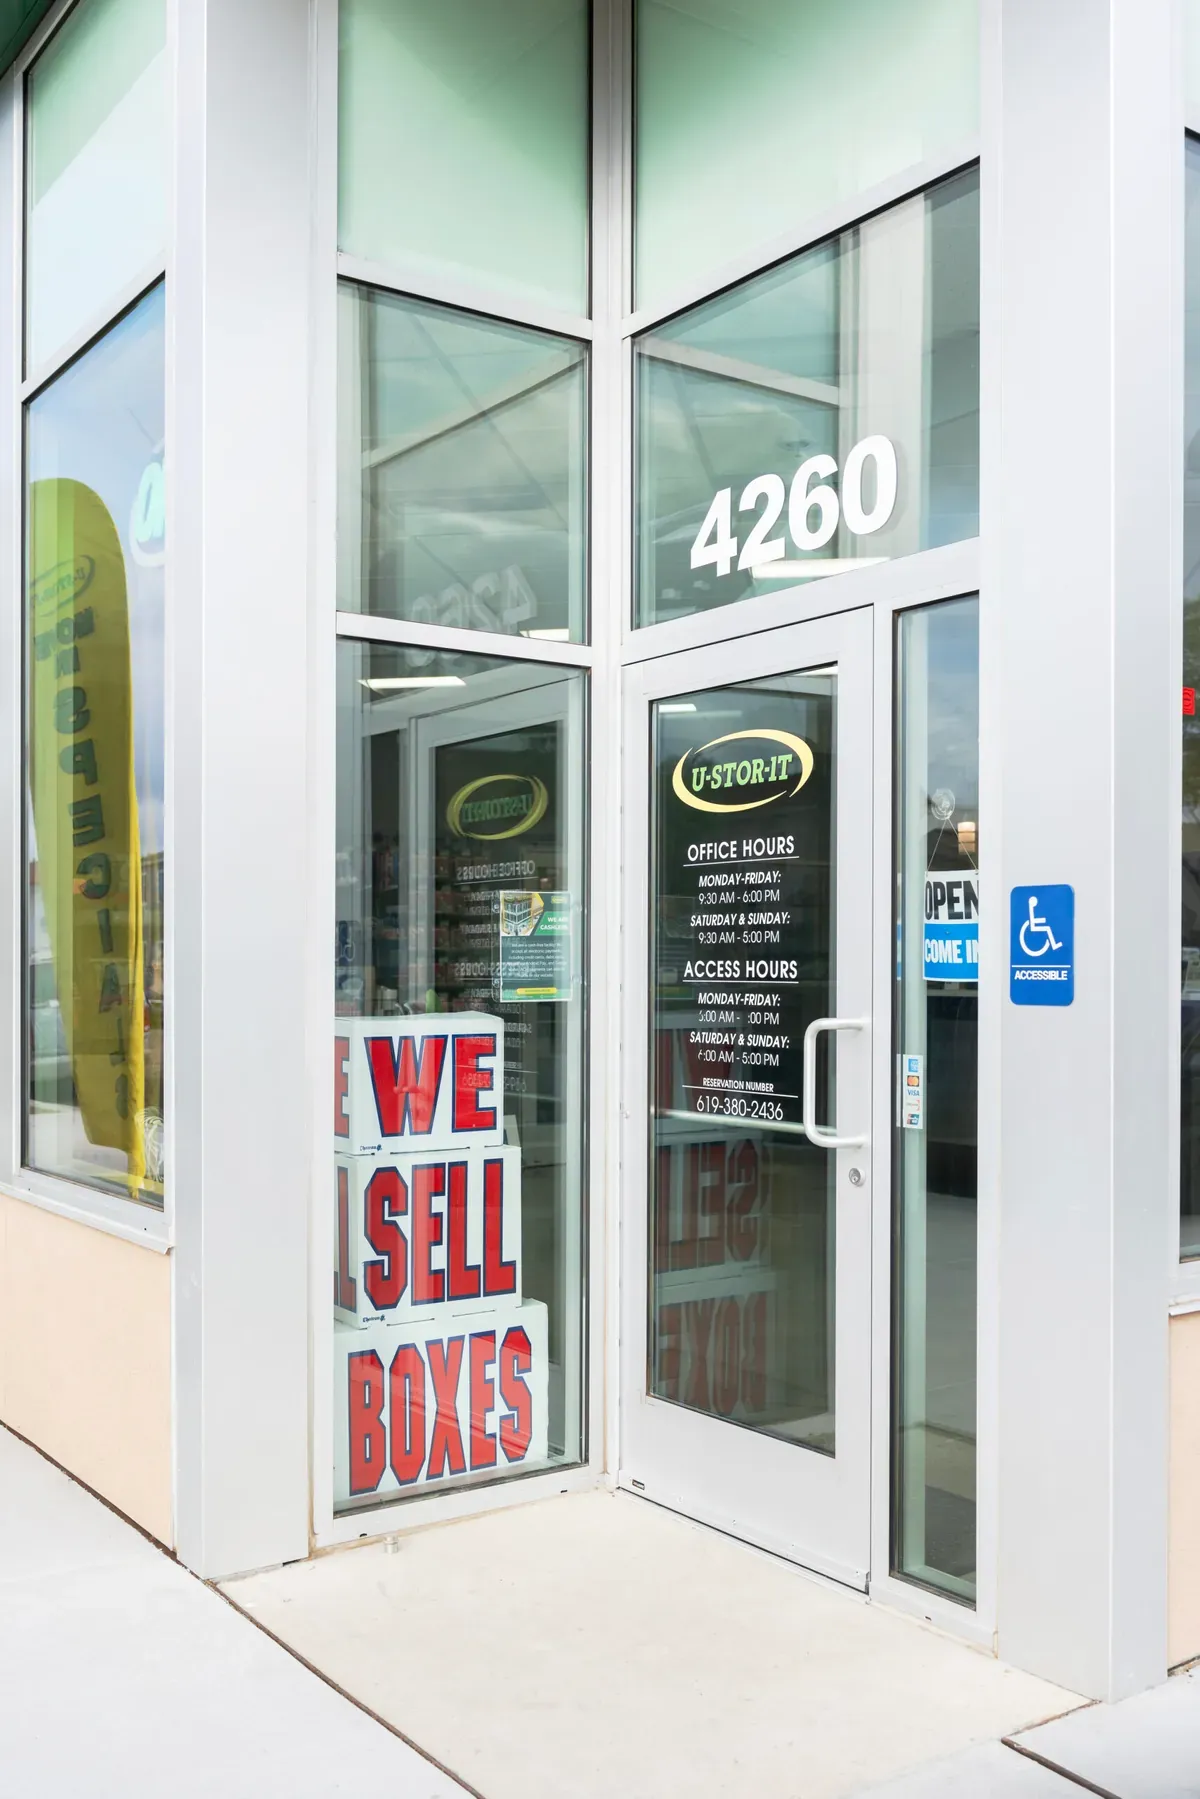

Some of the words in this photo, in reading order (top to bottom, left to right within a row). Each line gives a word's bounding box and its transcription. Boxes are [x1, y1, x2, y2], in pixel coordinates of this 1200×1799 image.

[690, 434, 898, 578] 4260
[692, 754, 793, 792] U-STOR-IT
[687, 840, 737, 861] OFFICE
[742, 835, 795, 857] HOURS
[698, 870, 782, 888] MONDAY-FRIDAY:
[698, 892, 717, 905] 9:30
[718, 891, 735, 904] AM
[742, 889, 762, 903] 6:00
[764, 889, 780, 902] PM
[925, 880, 979, 920] OPEN
[690, 913, 737, 927] SATURDAY
[738, 913, 746, 925] &
[747, 911, 791, 925] SUNDAY:
[698, 932, 717, 944] 9:30
[718, 931, 735, 944] AM
[742, 931, 762, 943] 5:00
[764, 930, 780, 943] PM
[925, 939, 963, 964] COME
[683, 960, 740, 978] ACCESS
[745, 960, 798, 979] HOURS
[1014, 970, 1068, 980] ACCESSIBLE
[698, 993, 781, 1007] MONDAY-FRIDAY:
[718, 1010, 735, 1023] AM
[747, 1012, 762, 1025] :00
[763, 1012, 780, 1025] PM
[689, 1031, 737, 1044] SATURDAY
[738, 1034, 745, 1045] &
[746, 1033, 790, 1049] SUNDAY:
[718, 1051, 734, 1063] AM
[742, 1052, 761, 1065] 5:00
[763, 1053, 779, 1067] PM
[364, 1033, 497, 1138] WE
[703, 1078, 745, 1090] RESERVATION
[745, 1081, 774, 1093] NUMBER
[696, 1095, 784, 1121] 619-380-2436
[364, 1158, 517, 1311] SELL
[348, 1325, 533, 1497] BOXES
